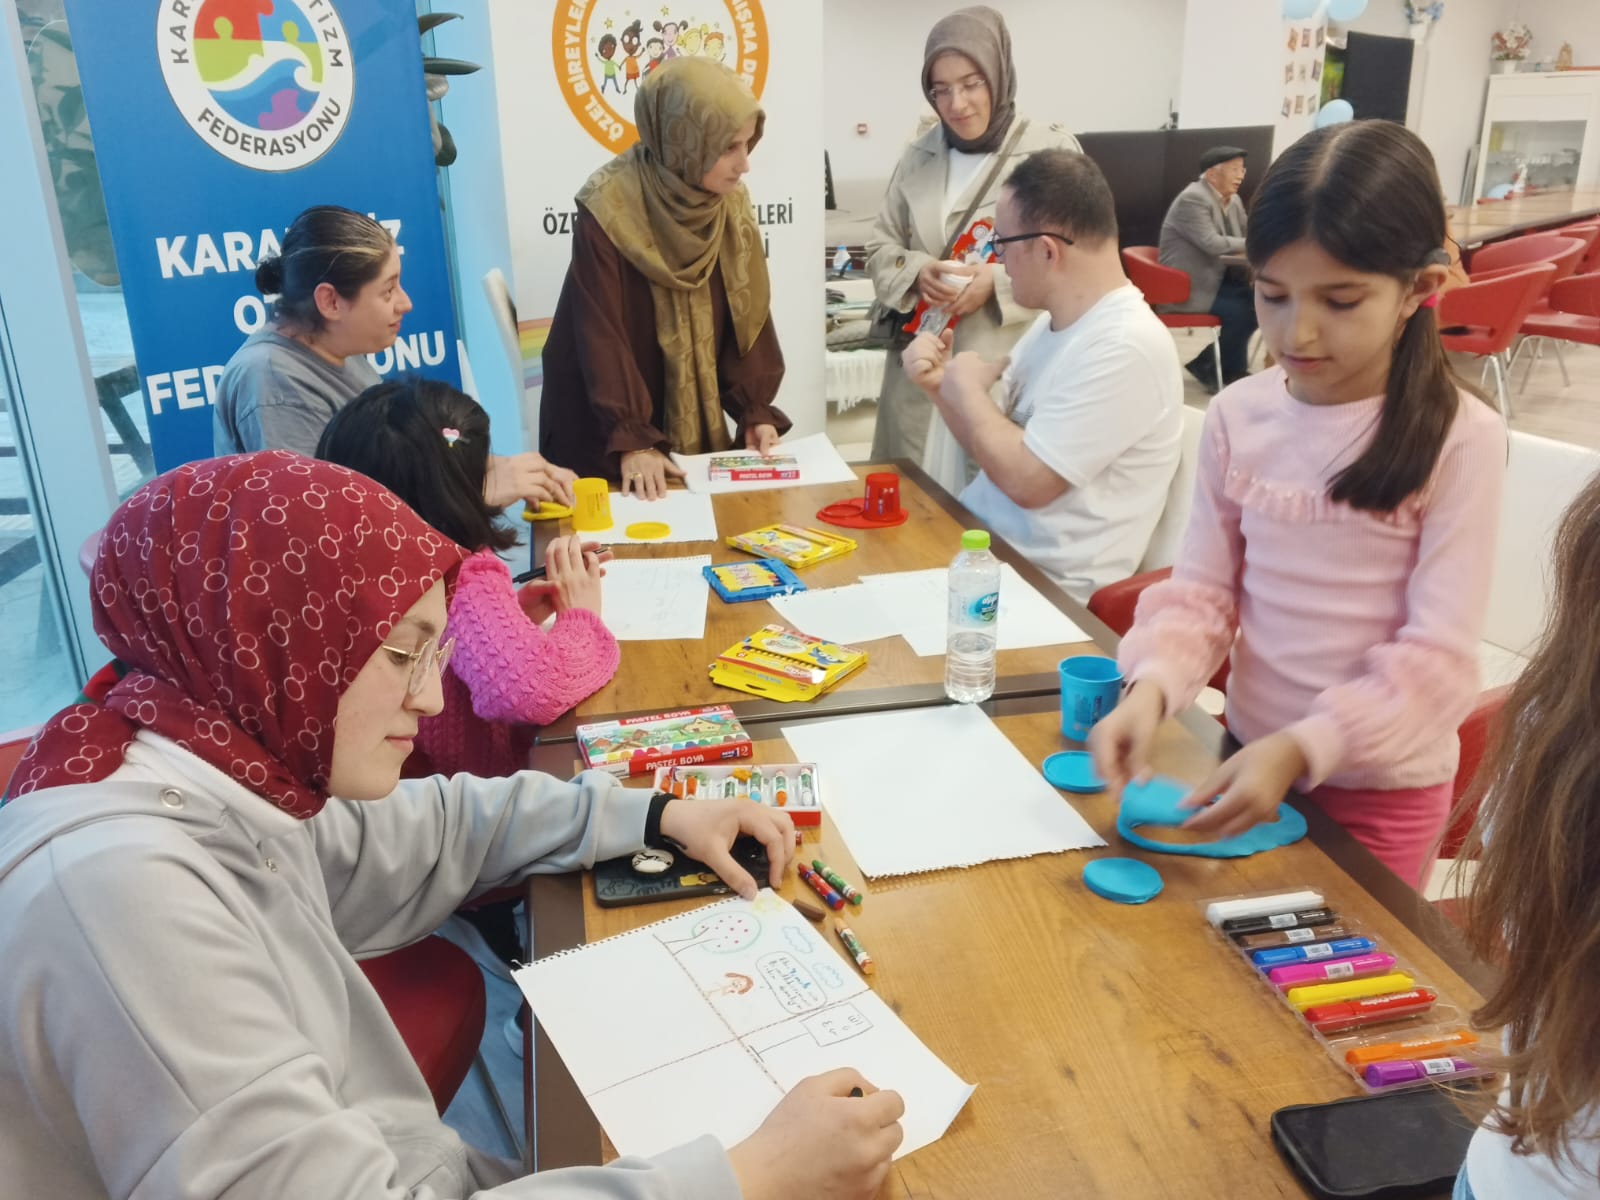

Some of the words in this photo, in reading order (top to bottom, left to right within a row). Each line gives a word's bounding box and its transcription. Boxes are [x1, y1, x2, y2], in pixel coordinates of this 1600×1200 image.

[170, 0, 196, 64] KAR
[308, 0, 344, 67] TİZM
[198, 98, 341, 157] FEDERASYONU
[585, 94, 624, 142] ÖZEL
[751, 196, 793, 225] LERİ
[625, 713, 663, 725] PASTEL
[663, 710, 692, 720] BOYA
[645, 759, 678, 771] PASTEL
[679, 754, 705, 766] BOYA
